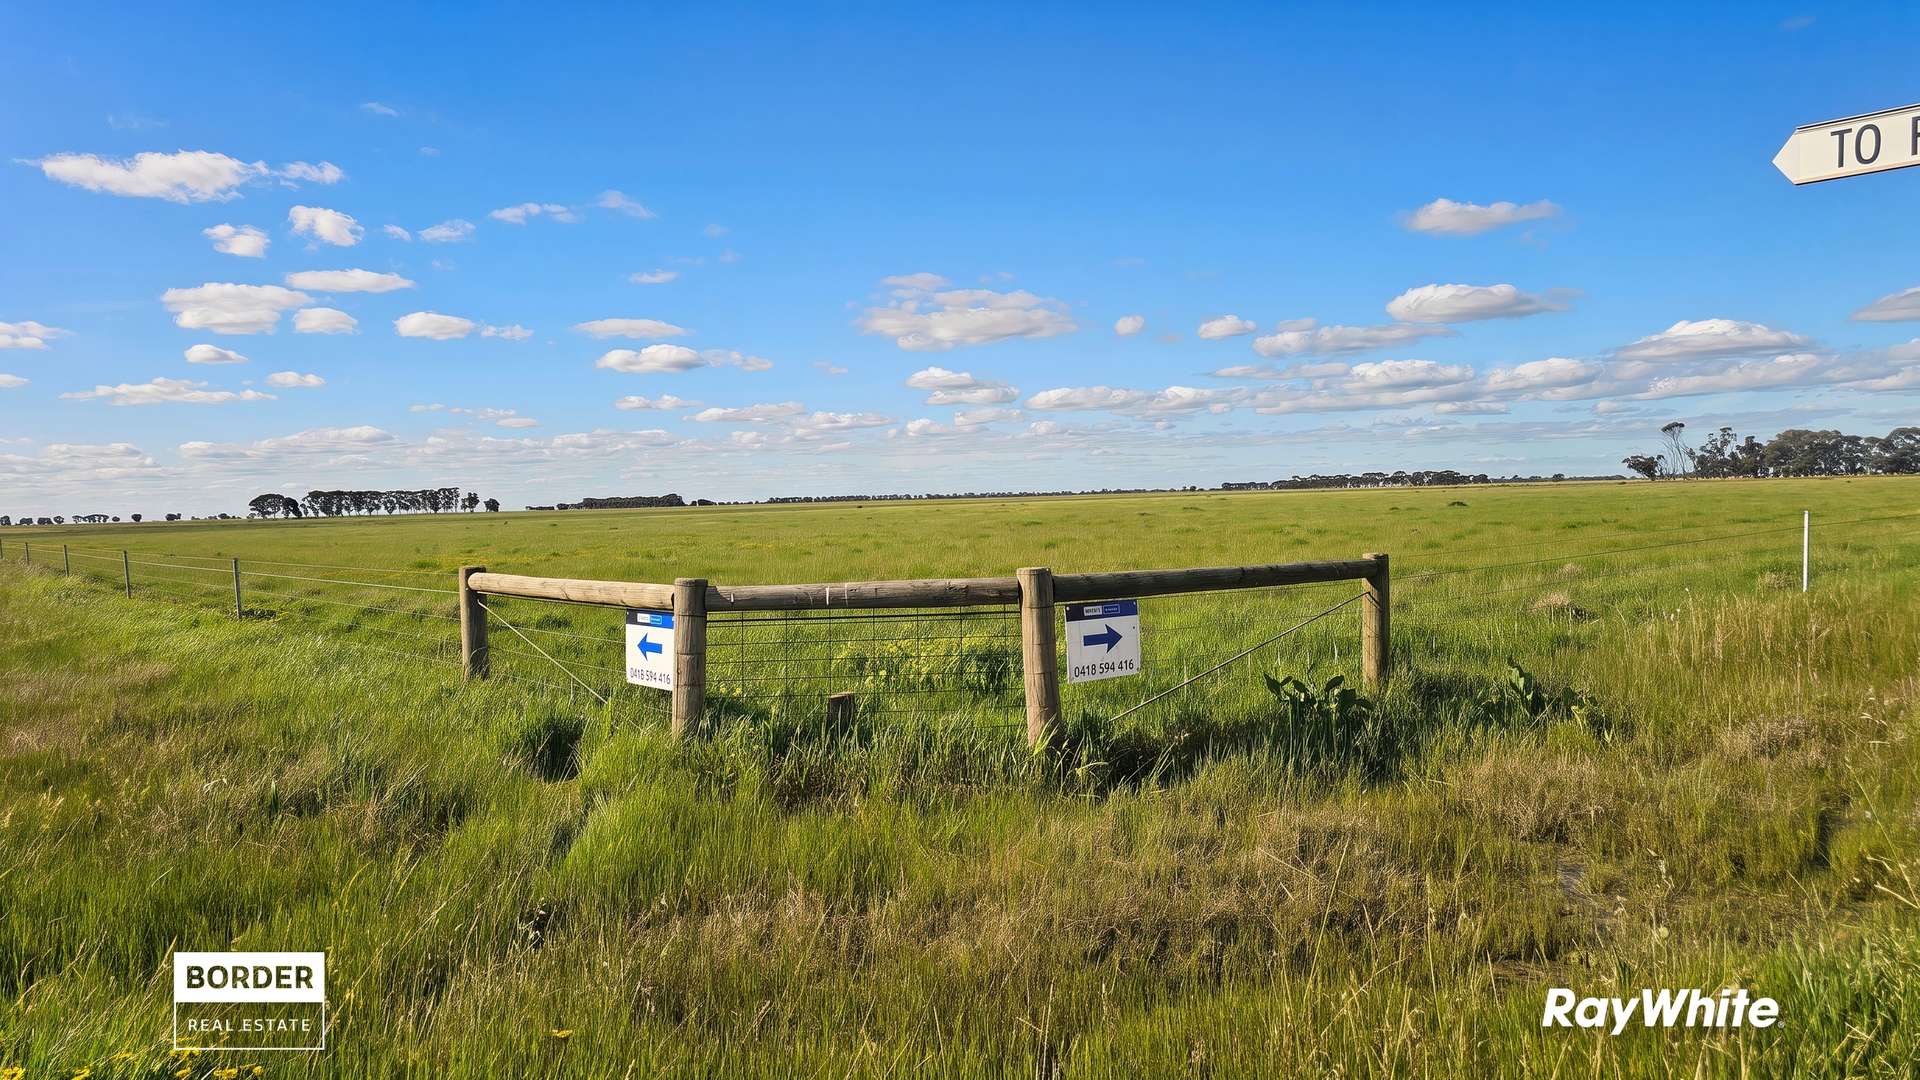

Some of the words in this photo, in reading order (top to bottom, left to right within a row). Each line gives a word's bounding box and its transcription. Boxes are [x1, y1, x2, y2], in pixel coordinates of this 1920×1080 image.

[1830, 123, 1882, 169] TO
[645, 669, 657, 683] 594
[658, 672, 671, 685] 416
[1074, 663, 1097, 678] 0418
[1099, 661, 1116, 674] 594
[1117, 659, 1134, 672] 416
